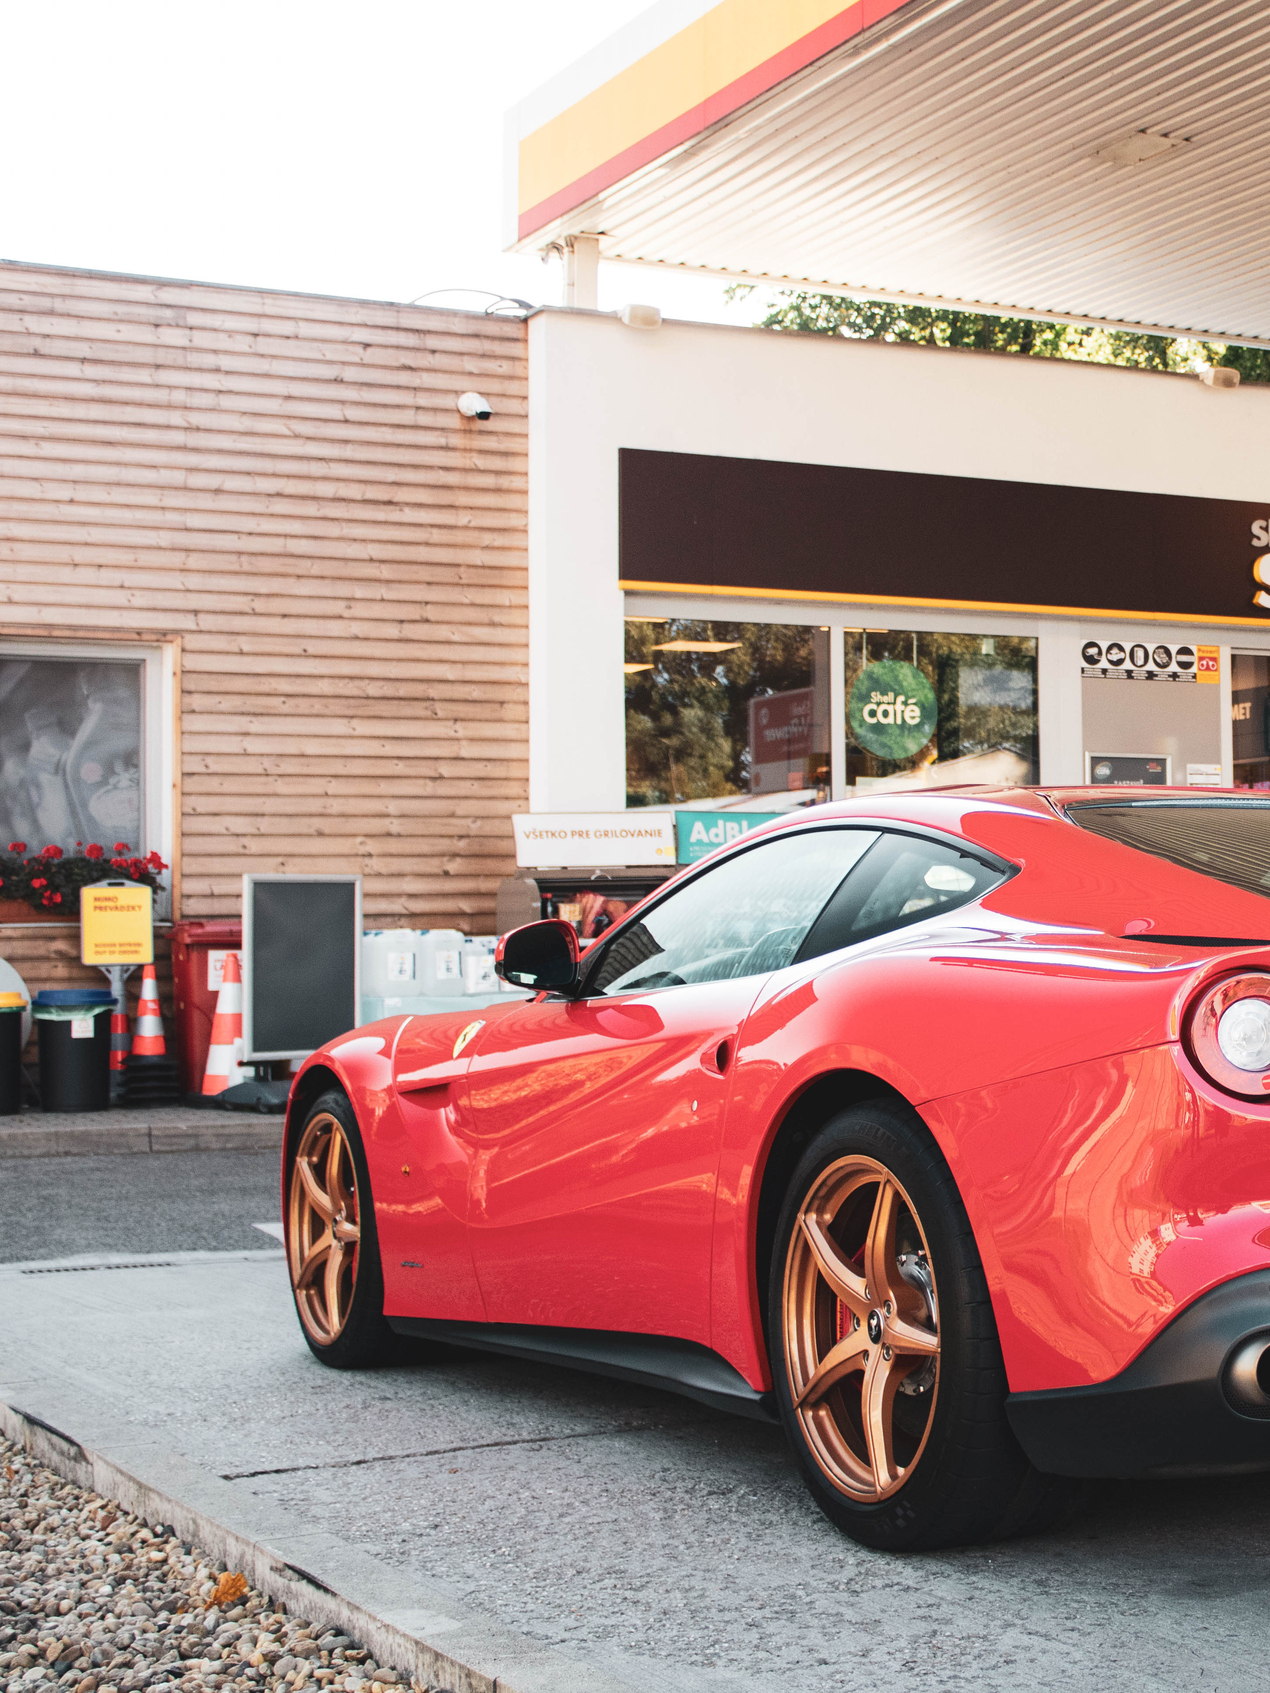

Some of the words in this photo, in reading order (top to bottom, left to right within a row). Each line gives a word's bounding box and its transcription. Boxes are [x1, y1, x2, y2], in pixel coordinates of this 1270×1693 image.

[870, 691, 894, 703] Shell
[863, 695, 921, 725] café
[523, 828, 568, 840] VŠETKO
[570, 829, 591, 840] PRE
[593, 828, 663, 840] GRILOVANIE
